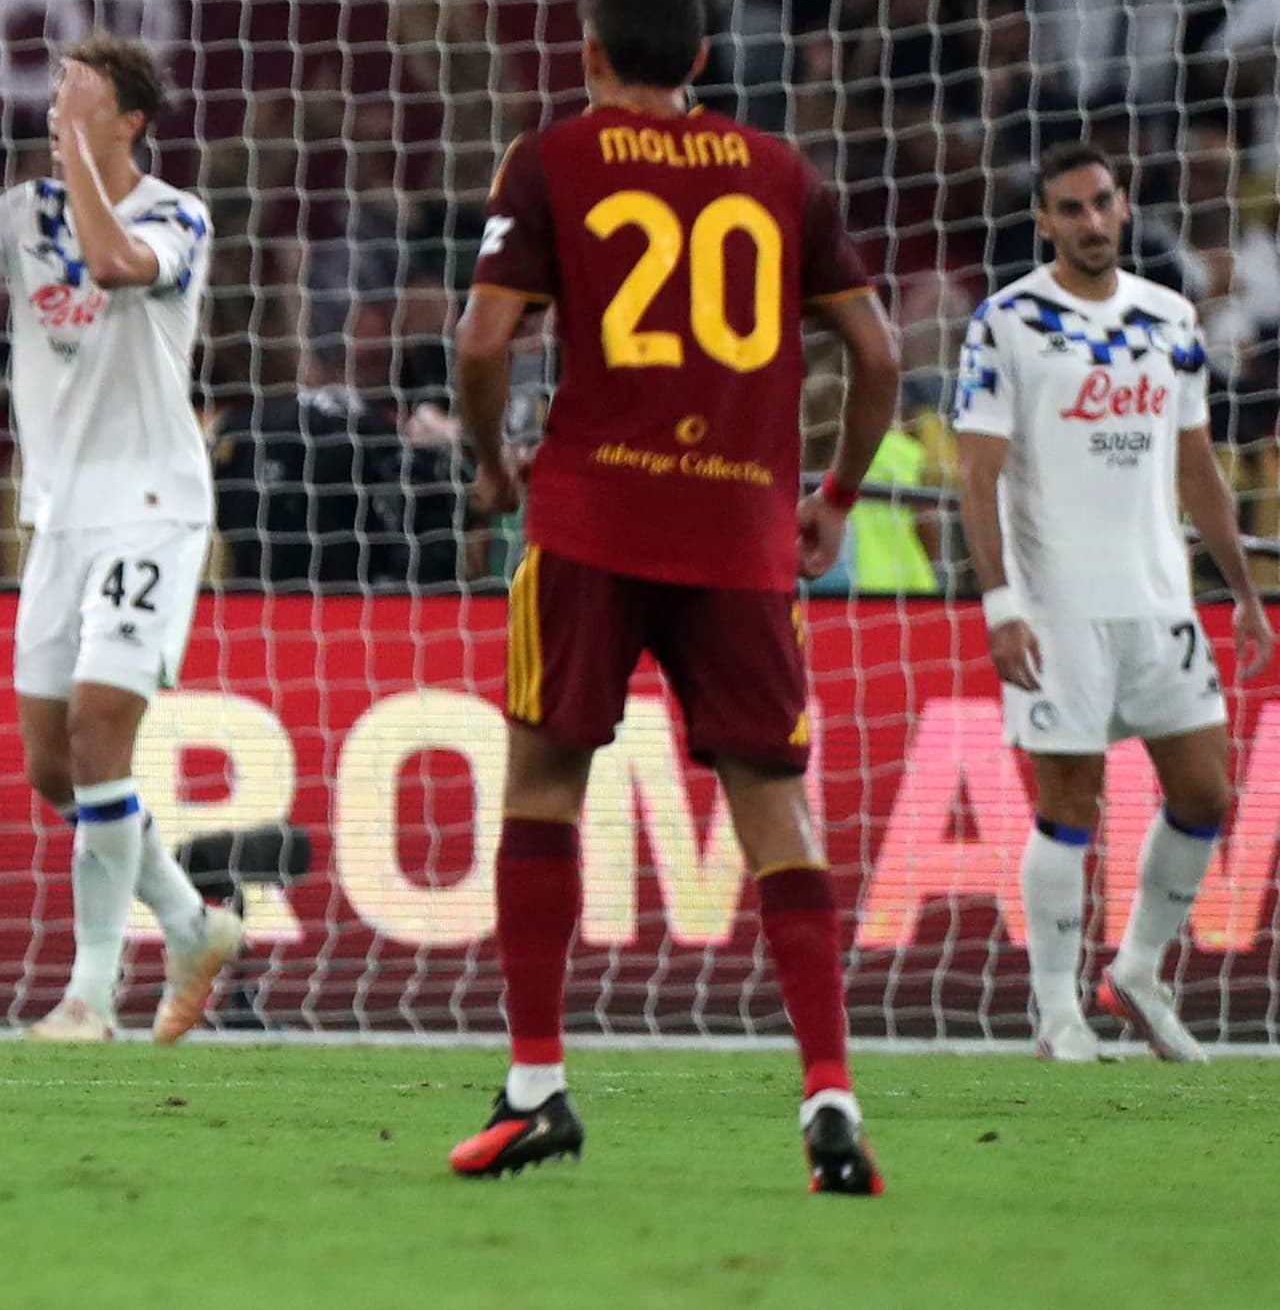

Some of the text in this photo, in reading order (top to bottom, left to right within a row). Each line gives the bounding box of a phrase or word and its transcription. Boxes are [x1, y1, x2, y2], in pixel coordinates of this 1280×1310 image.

[599, 126, 751, 168] MOLINA
[584, 191, 782, 374] 20
[1059, 367, 1167, 423] Lete
[101, 558, 160, 611] 42
[1170, 620, 1213, 671] 7
